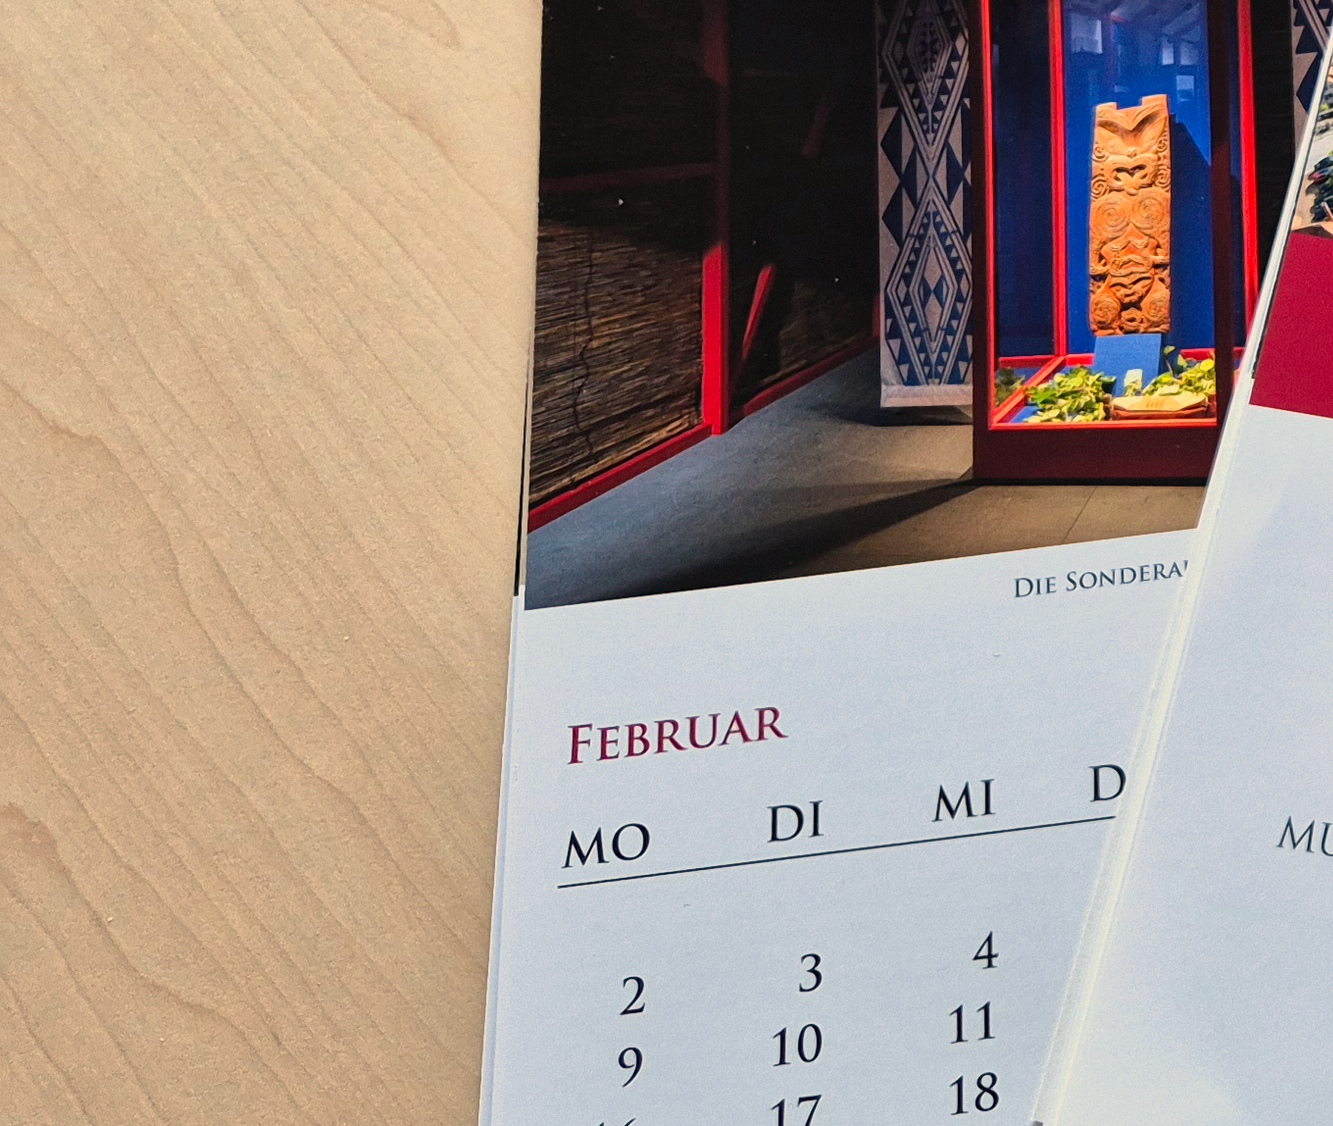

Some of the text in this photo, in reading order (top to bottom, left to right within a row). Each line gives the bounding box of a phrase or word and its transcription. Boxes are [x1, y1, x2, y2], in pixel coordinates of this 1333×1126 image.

[1014, 560, 1189, 598] DIE SONDERA
[567, 707, 788, 765] FEBRUAR
[561, 763, 1127, 869] MO DI MI D
[619, 931, 999, 1016] 2 3 4
[617, 1001, 996, 1087] 9 10 11
[771, 1072, 1000, 1126] 17 18
